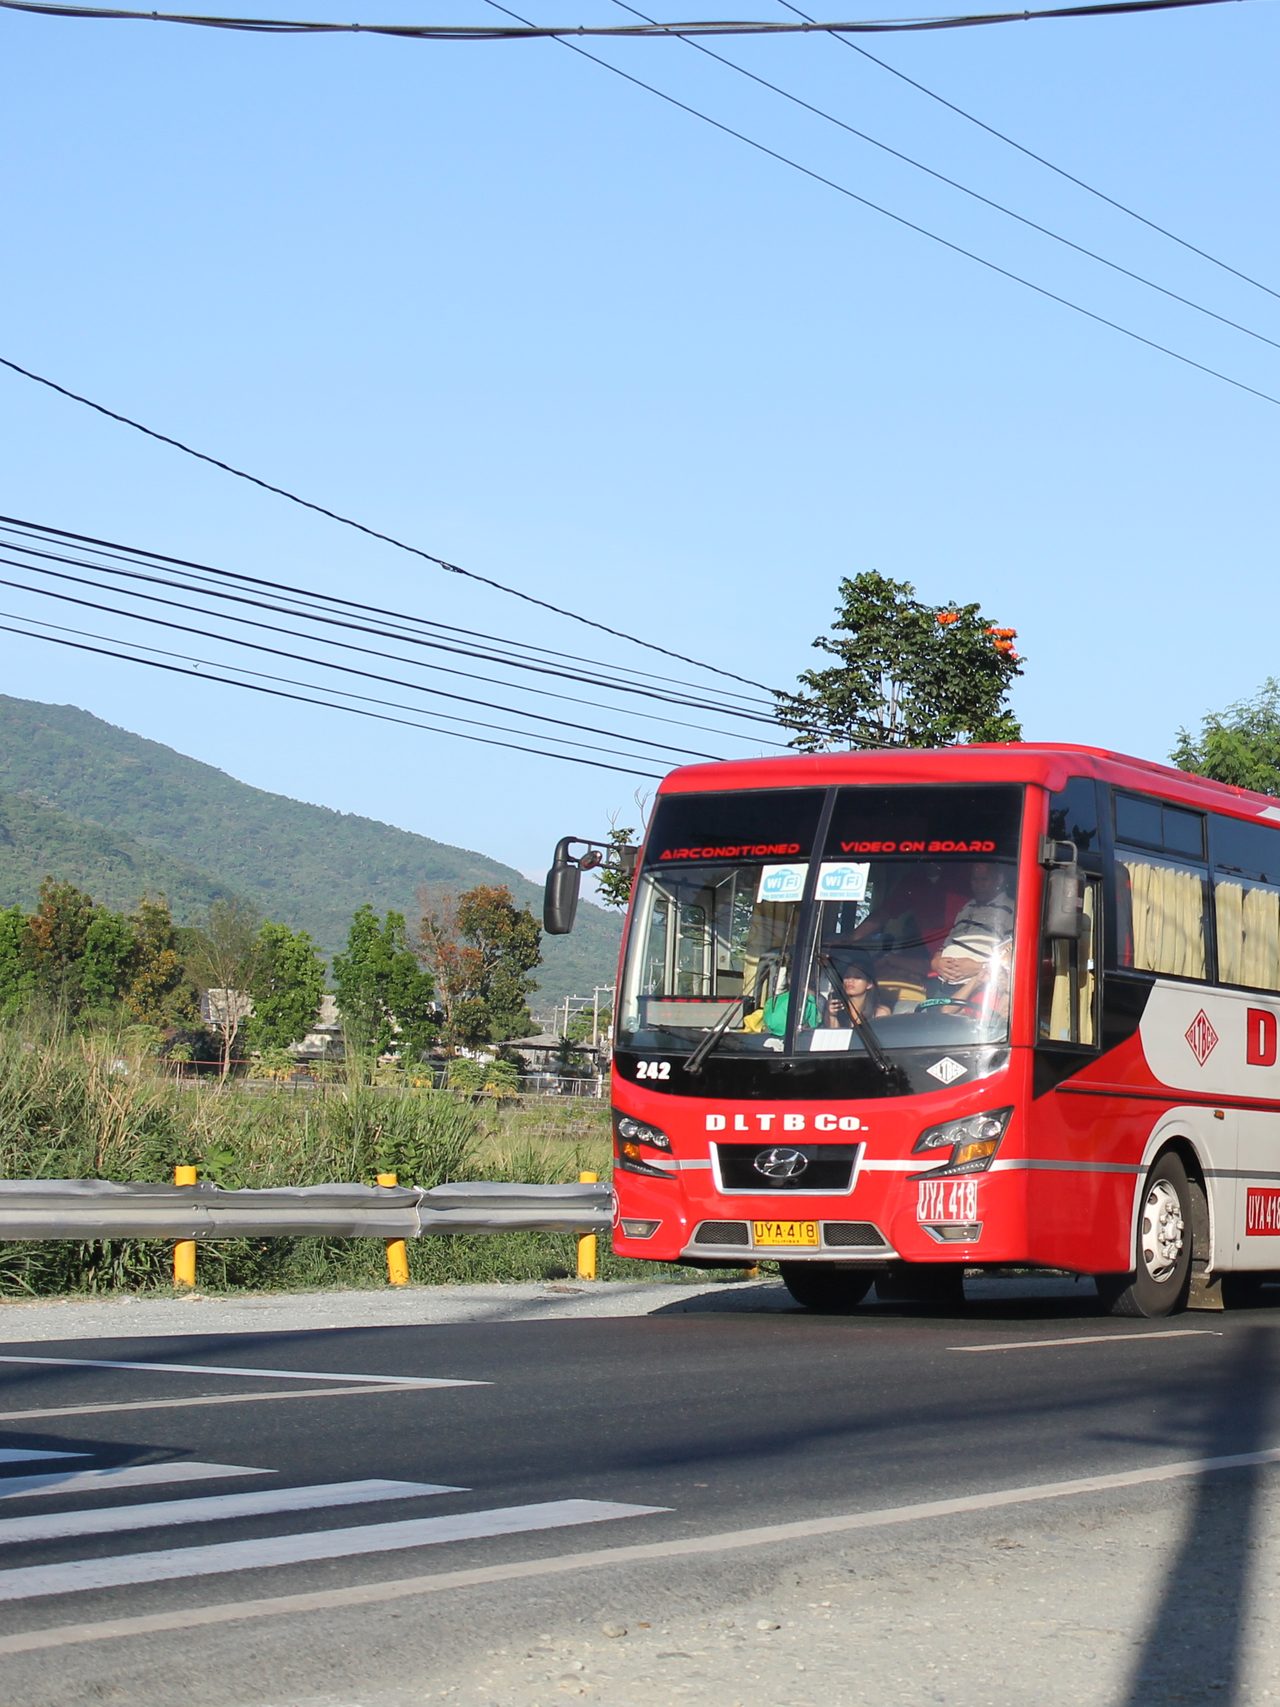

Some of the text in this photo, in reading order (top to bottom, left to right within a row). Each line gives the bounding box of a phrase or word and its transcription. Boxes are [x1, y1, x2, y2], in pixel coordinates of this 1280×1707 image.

[660, 843, 800, 860] AIRCONDITIONED
[841, 840, 995, 853] VIDEO ON BOARD
[636, 1061, 671, 1079] 242
[919, 1182, 975, 1220] UYA 418
[1249, 1194, 1265, 1229] UYA
